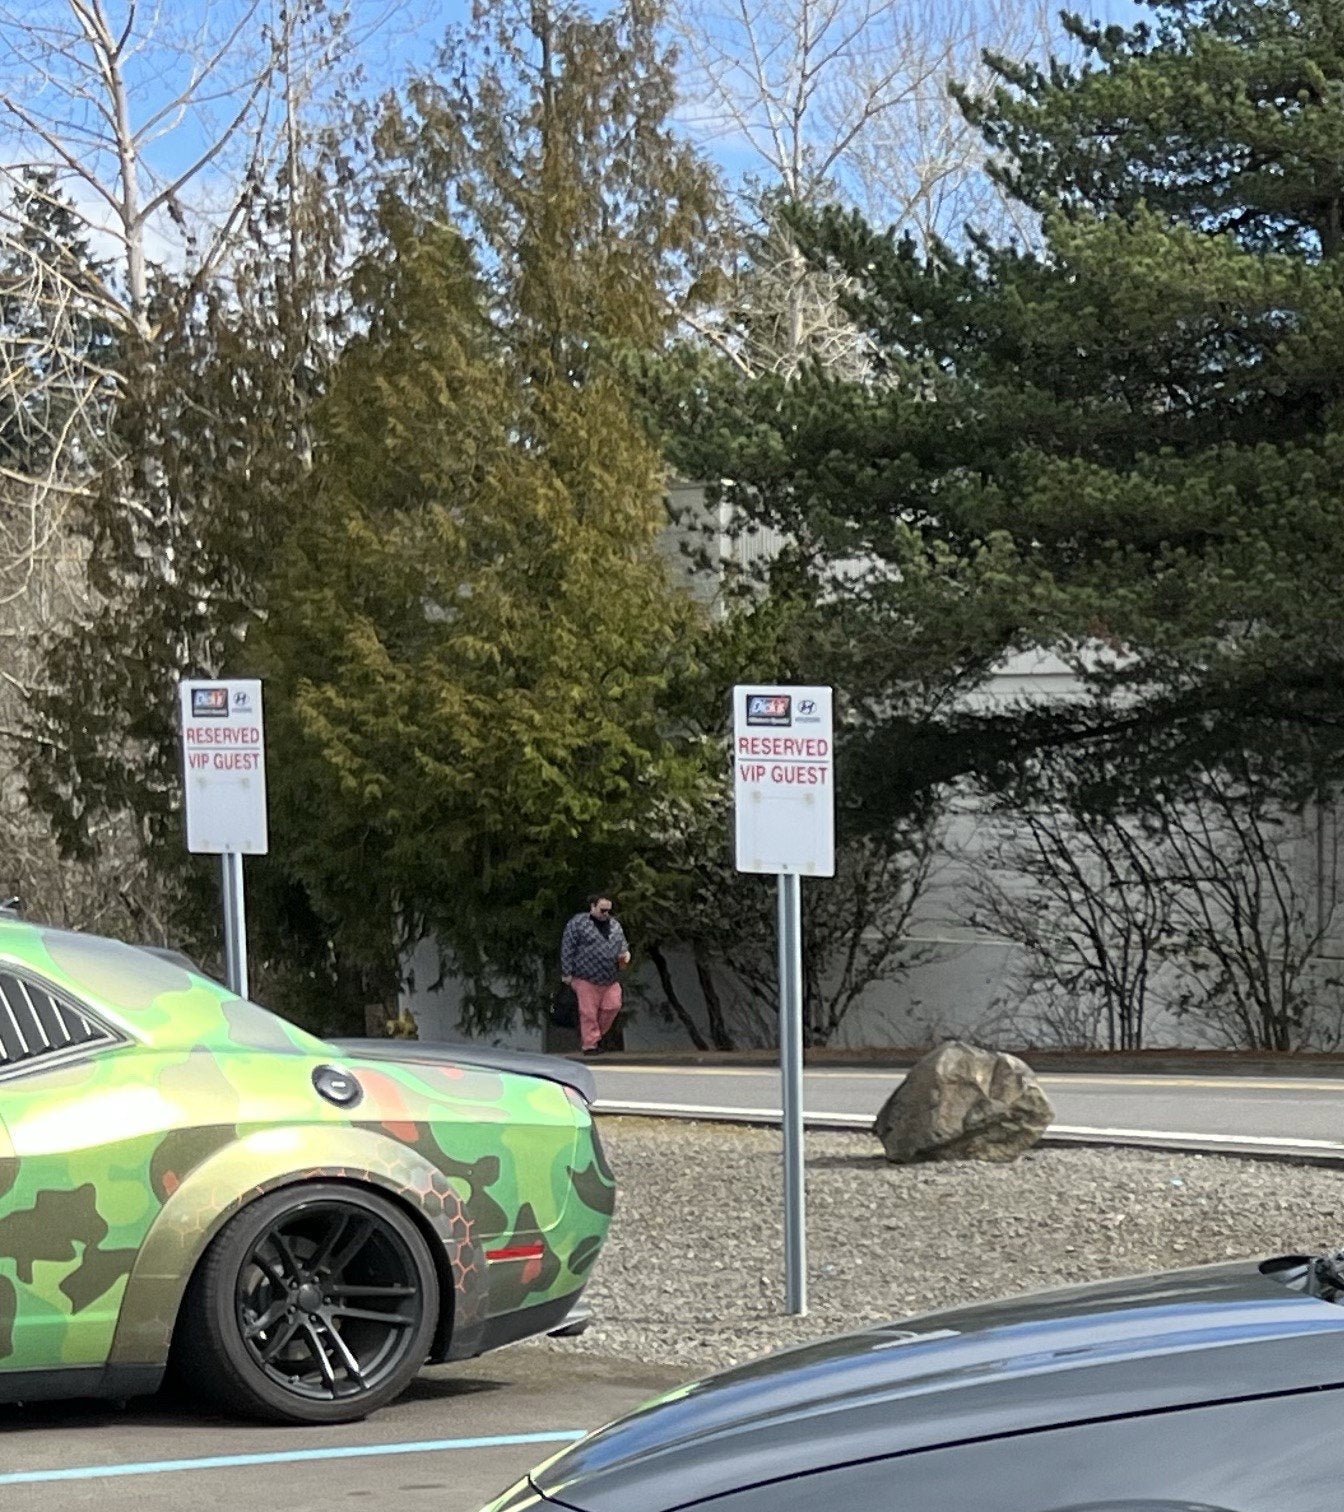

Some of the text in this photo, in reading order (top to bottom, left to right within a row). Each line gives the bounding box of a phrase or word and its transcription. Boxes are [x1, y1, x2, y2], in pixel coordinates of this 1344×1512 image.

[186, 727, 260, 744] RESERVED
[738, 737, 829, 757] RESERVED
[188, 753, 261, 770] VIP GUEST
[740, 764, 828, 785] VIP GUEST
